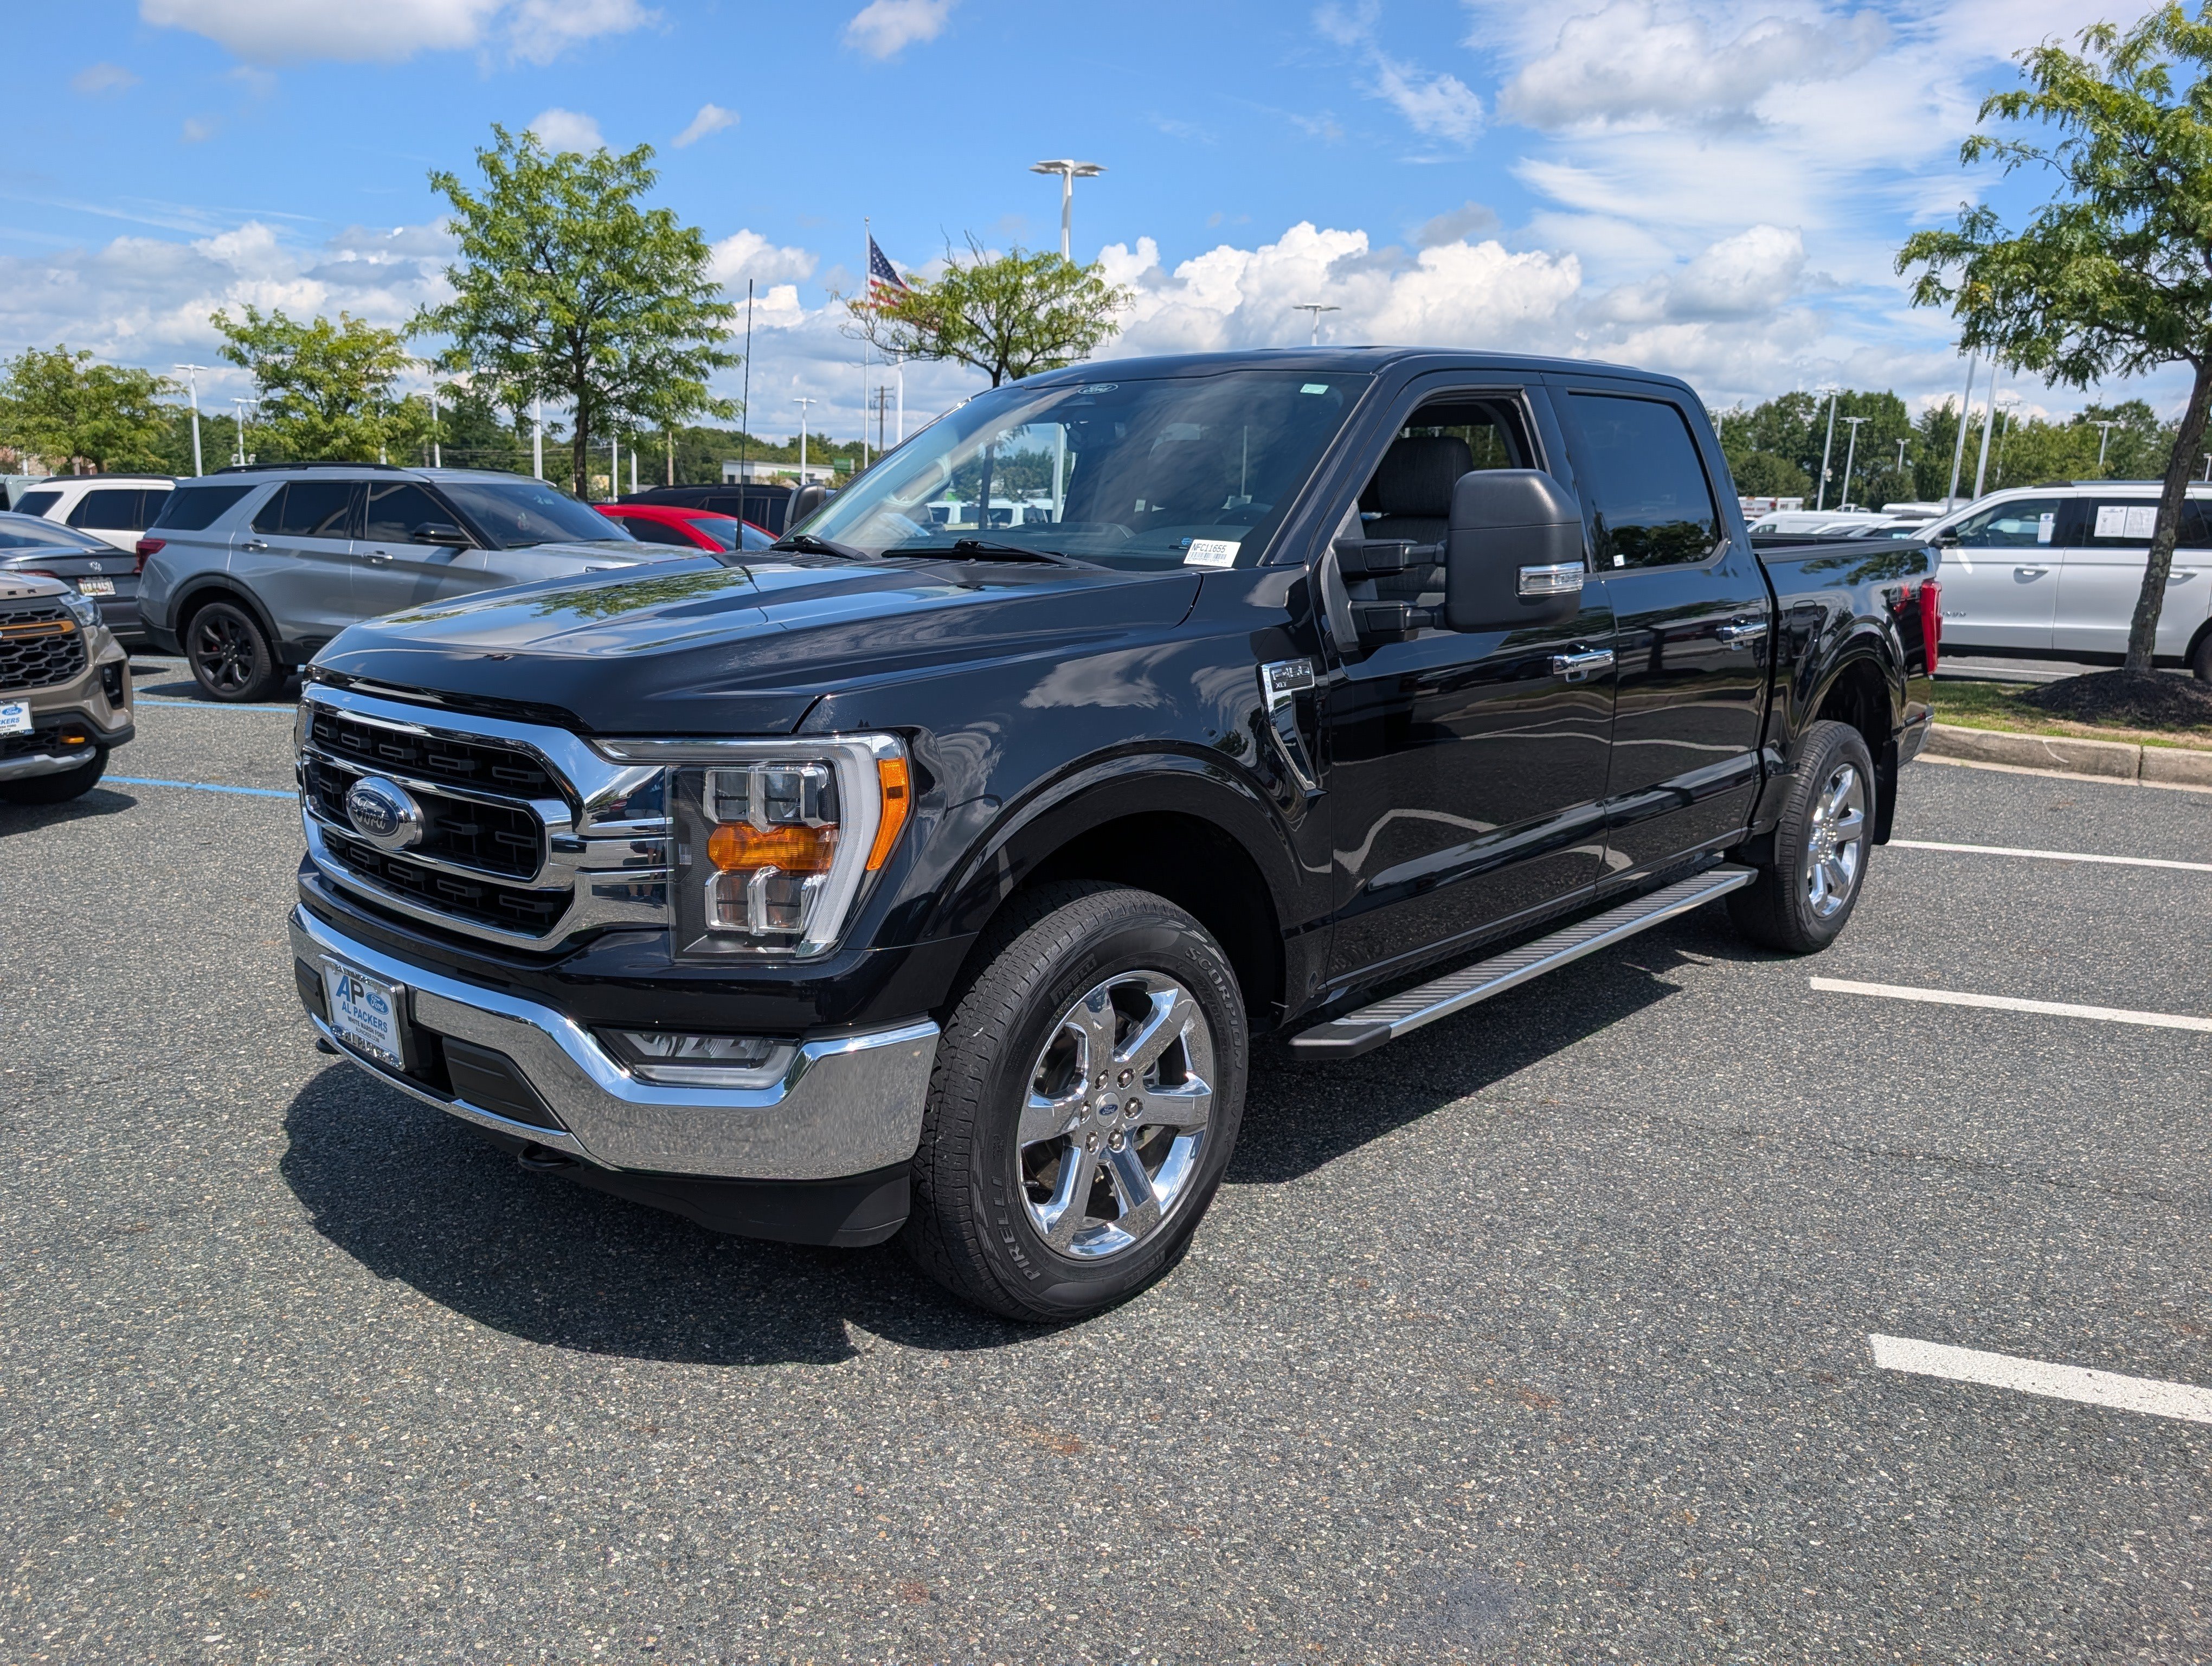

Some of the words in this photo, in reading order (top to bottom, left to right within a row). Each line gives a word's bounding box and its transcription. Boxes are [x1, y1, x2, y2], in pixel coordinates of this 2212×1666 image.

[1084, 385, 1113, 393] Ford
[1191, 543, 1227, 553] NFC11655
[355, 796, 387, 830] Ford
[336, 975, 365, 1005] AP
[1049, 953, 1097, 1006] PIRELLI
[342, 1001, 351, 1015] AL
[353, 1007, 388, 1034] PACKERS
[371, 995, 385, 1013] Ford
[1185, 946, 1242, 1071] SCORPION
[1102, 1105, 1116, 1114] Ford
[992, 1176, 1041, 1280] PIRELLI
